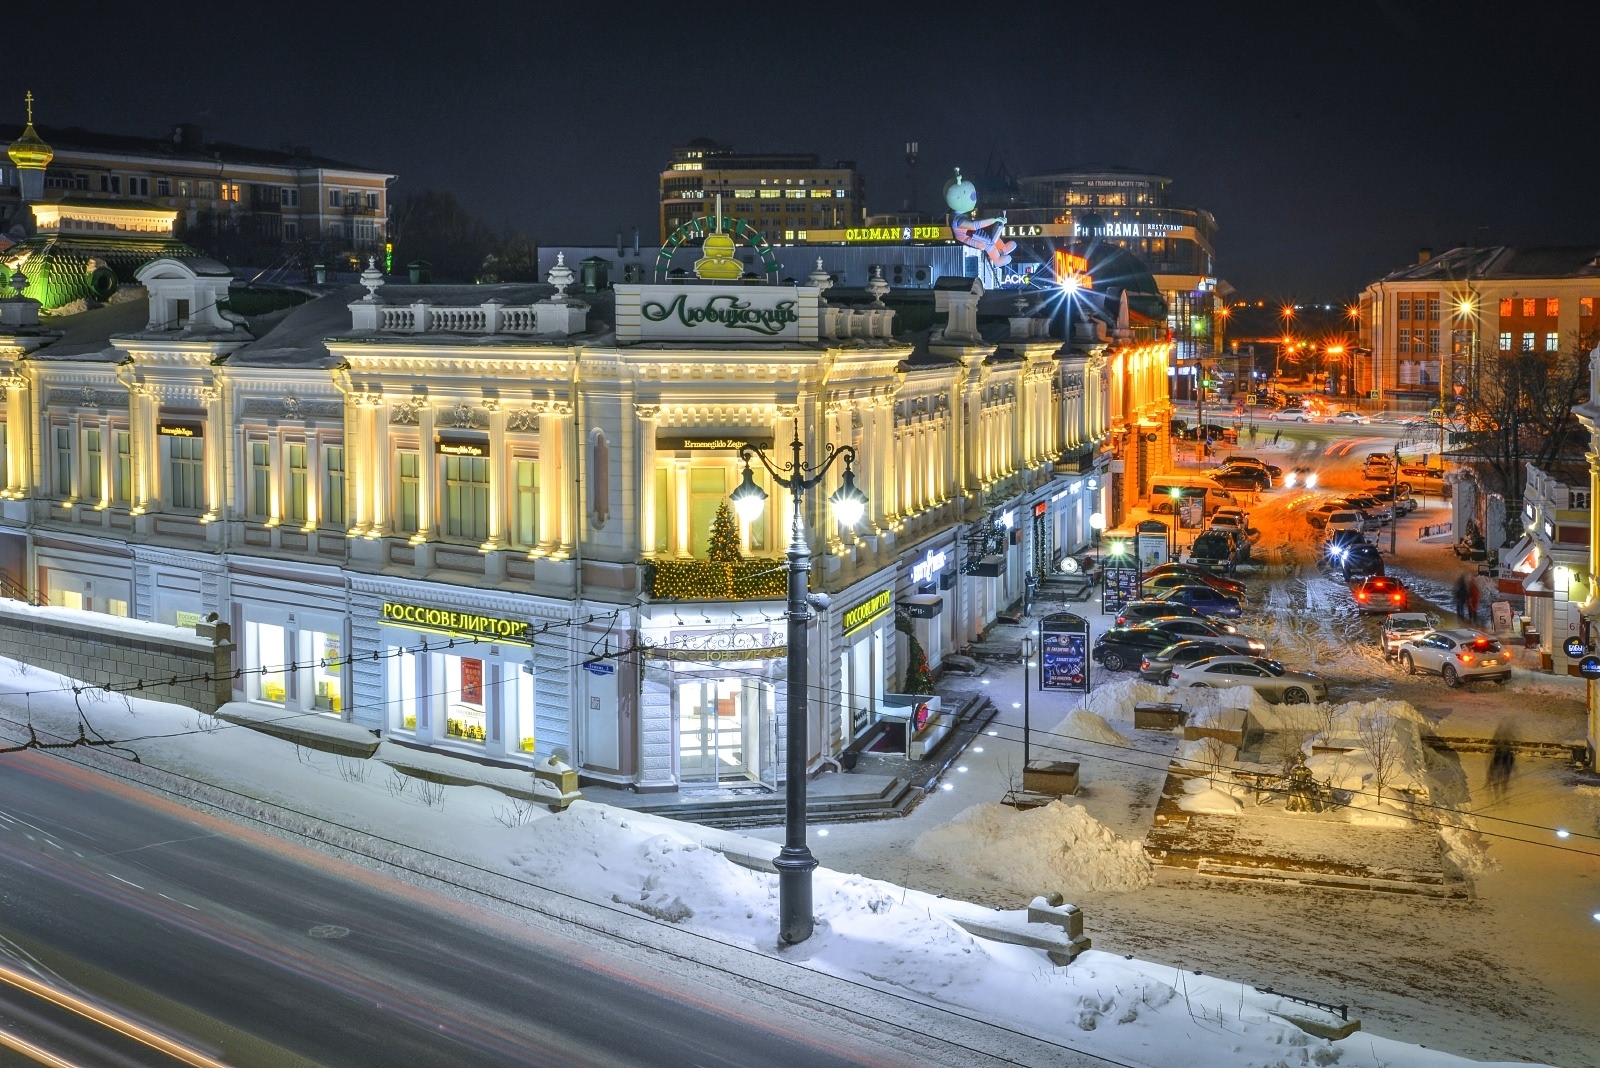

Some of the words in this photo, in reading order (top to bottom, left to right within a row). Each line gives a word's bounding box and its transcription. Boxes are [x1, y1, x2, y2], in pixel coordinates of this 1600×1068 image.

[1147, 223, 1184, 231] RESTAURANT
[845, 227, 900, 240] OLDMAN
[913, 226, 940, 239] PUB
[684, 440, 726, 449] Ermenegildo
[383, 602, 528, 637] РОССЮВЕЛИРТОРГ
